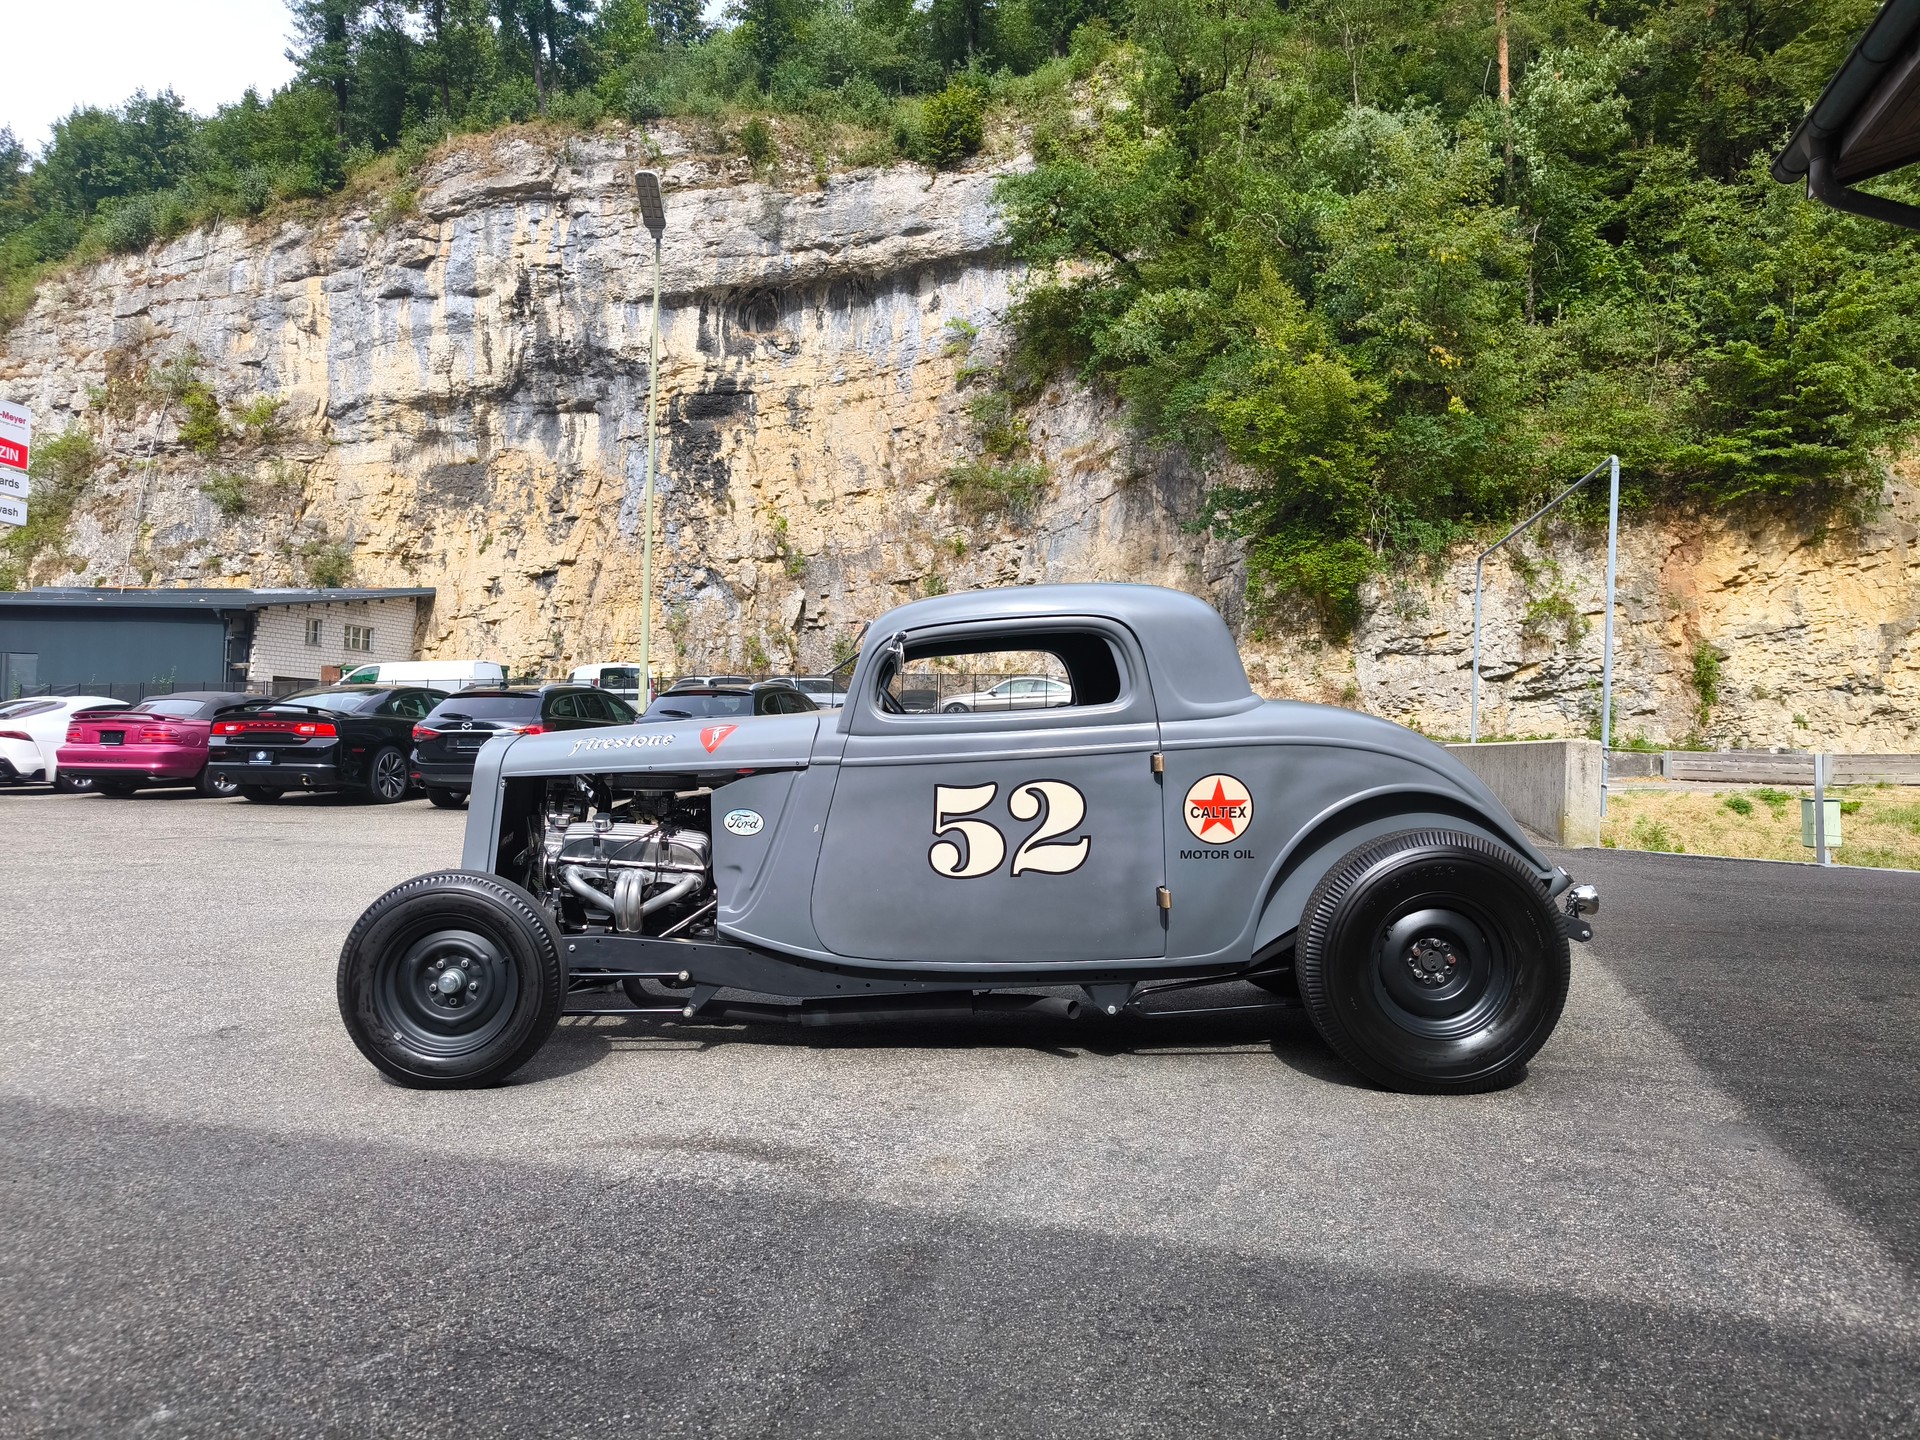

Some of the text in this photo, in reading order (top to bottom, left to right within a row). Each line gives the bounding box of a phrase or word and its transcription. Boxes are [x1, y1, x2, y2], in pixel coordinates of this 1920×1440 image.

[567, 735, 676, 757] Firestone
[1190, 806, 1246, 818] CALTEX
[728, 814, 759, 829] Ford
[928, 778, 1091, 879] 52
[1180, 850, 1255, 859] MOTOR OIL
